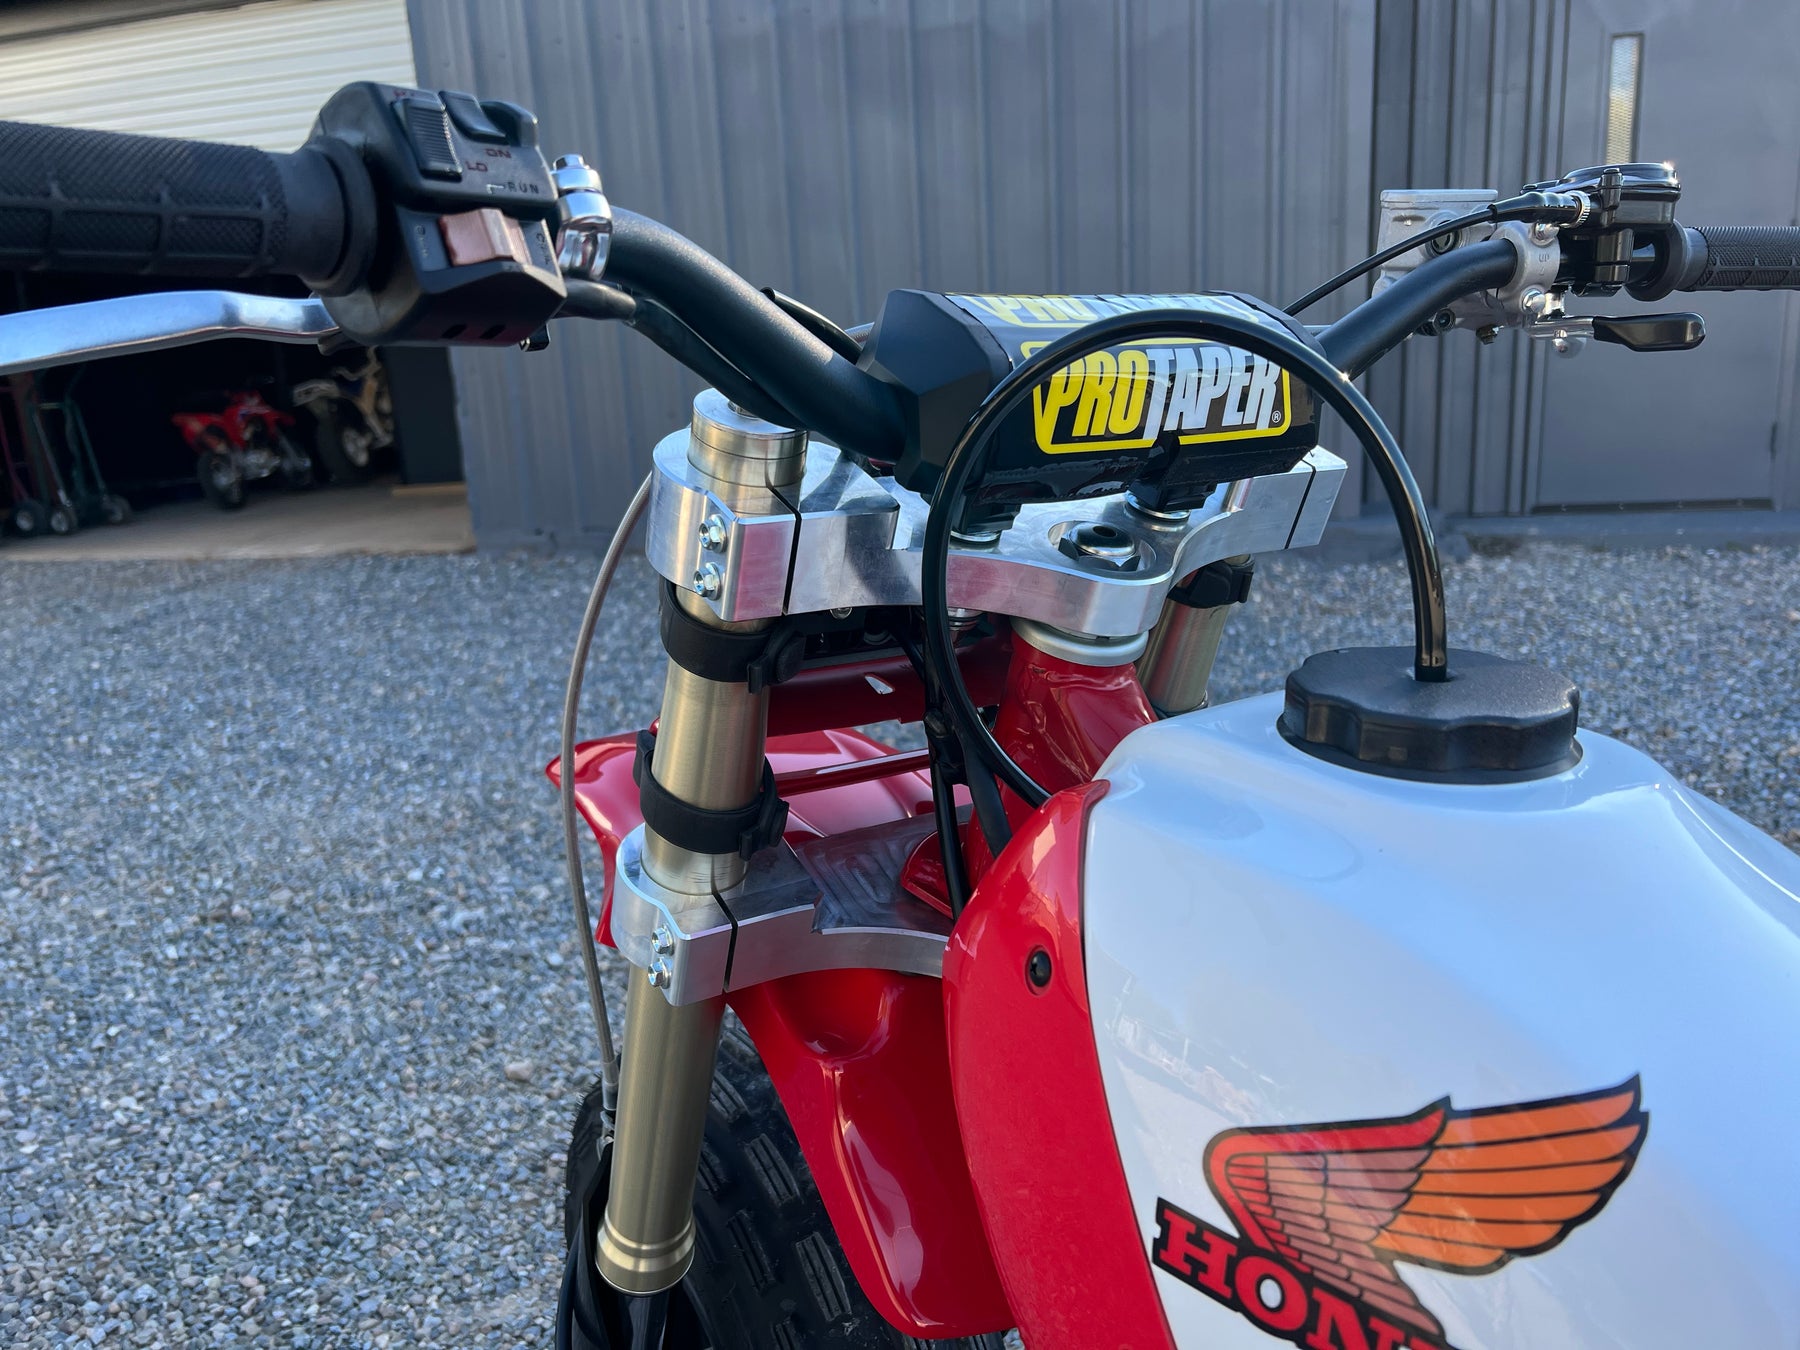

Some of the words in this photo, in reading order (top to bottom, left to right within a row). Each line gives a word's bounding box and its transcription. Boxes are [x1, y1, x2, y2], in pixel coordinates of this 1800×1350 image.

[485, 148, 512, 159] ON
[465, 160, 488, 172] LO
[507, 180, 540, 194] RUN
[1538, 253, 1550, 263] UP
[1156, 1204, 1442, 1350] HON
